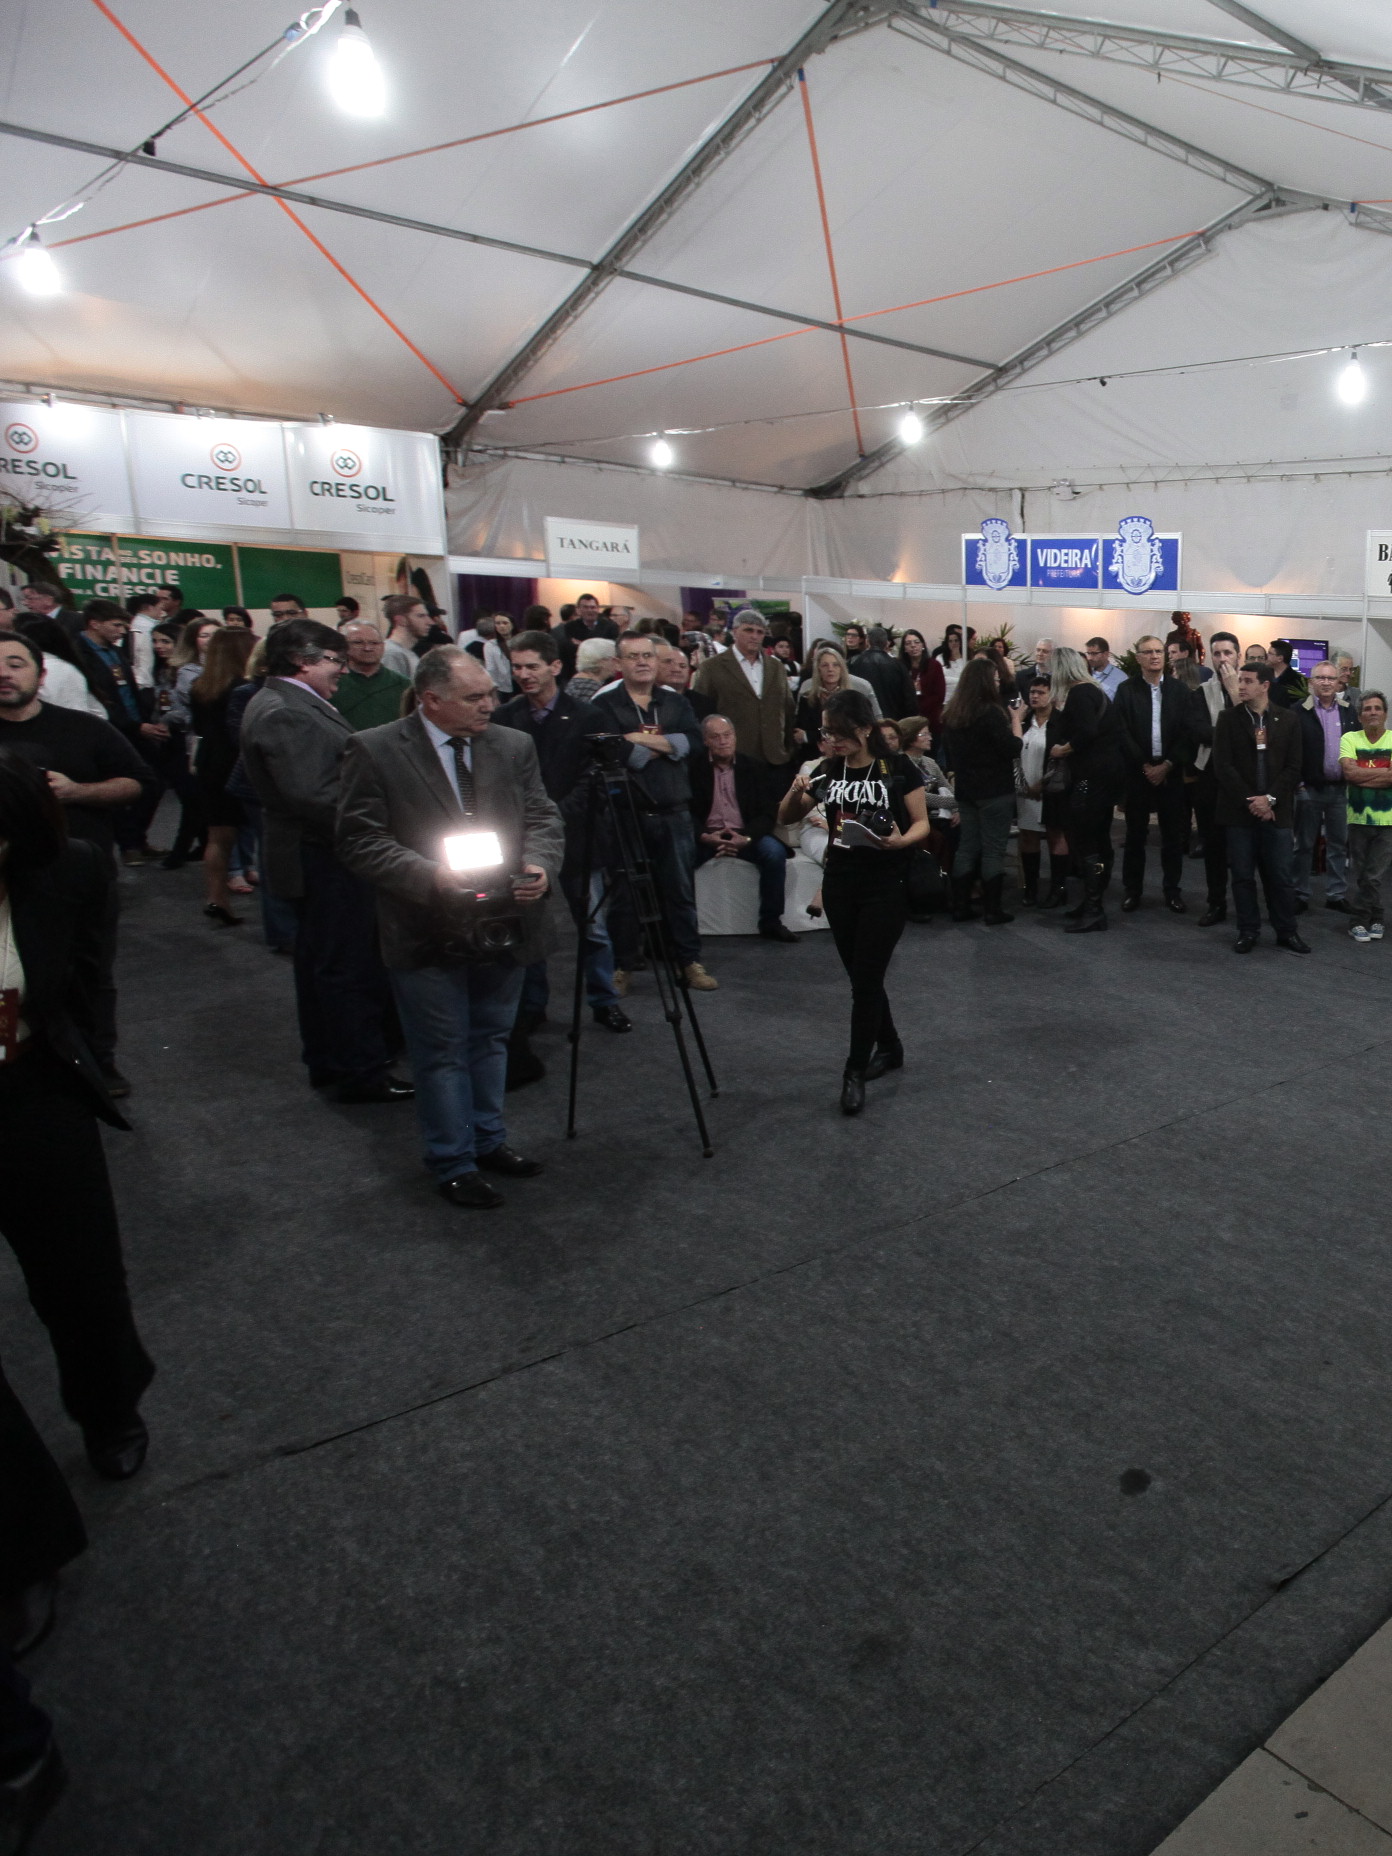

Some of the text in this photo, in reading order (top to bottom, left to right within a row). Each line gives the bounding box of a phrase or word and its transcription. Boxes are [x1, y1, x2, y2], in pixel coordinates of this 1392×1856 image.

[0, 457, 78, 480] RESOL
[181, 473, 268, 494] CRESOL
[310, 480, 395, 502] CRESOL
[356, 503, 396, 515] Sicoper
[557, 536, 631, 554] TANGARÁ
[1036, 548, 1092, 568] VIDEIRA
[57, 562, 181, 585] FINANCIE
[95, 583, 159, 597] CRES
